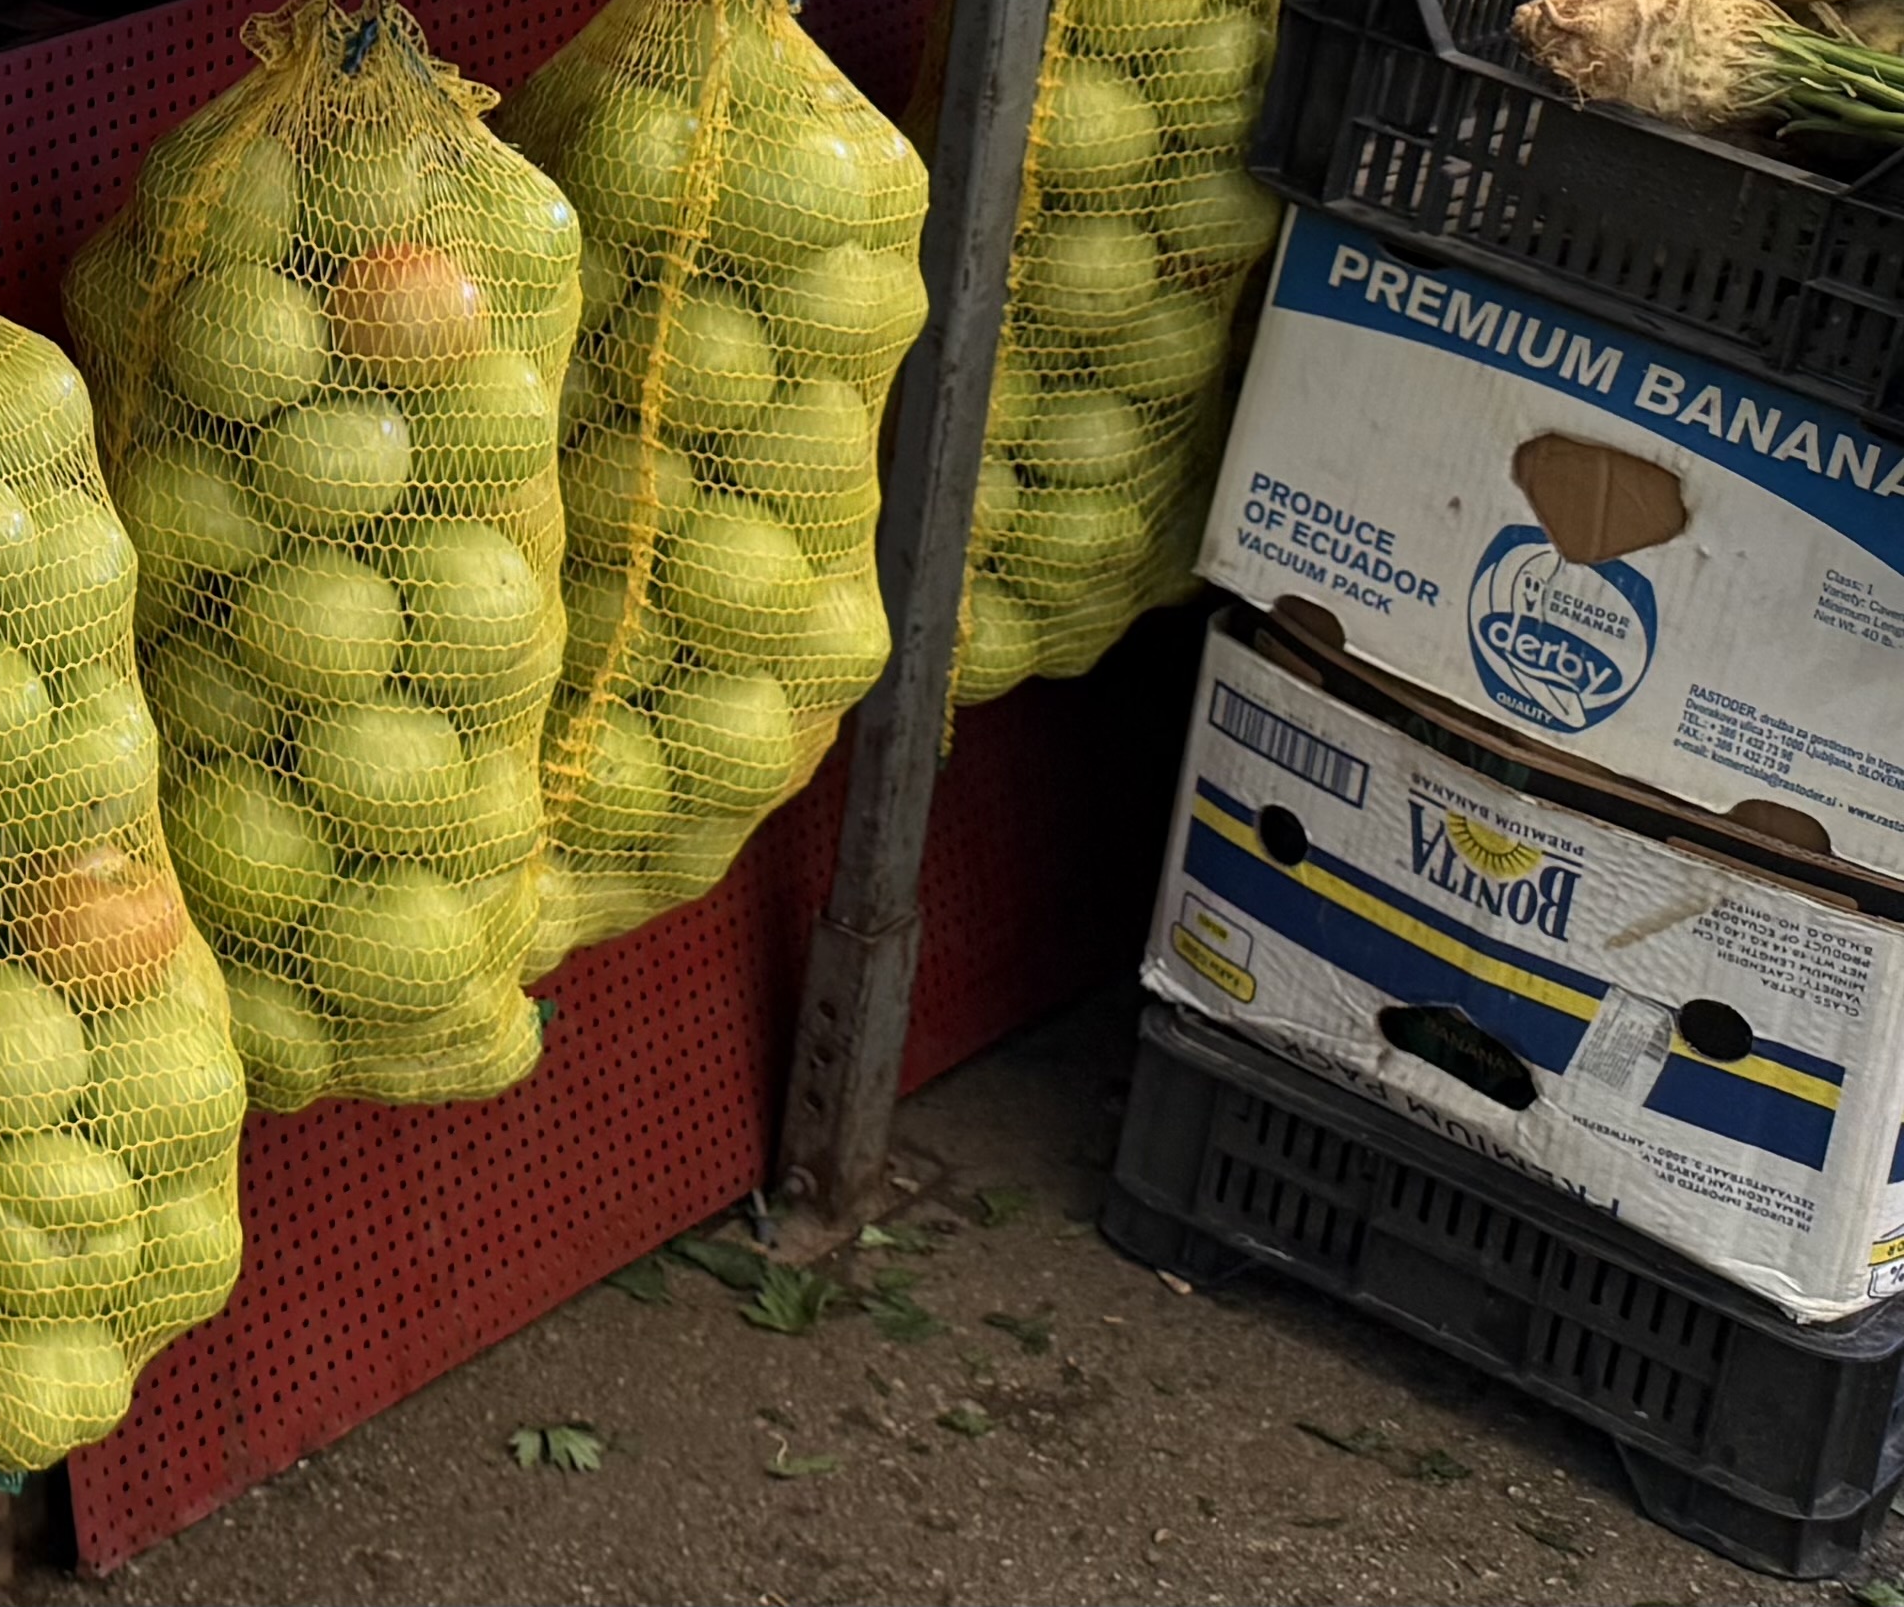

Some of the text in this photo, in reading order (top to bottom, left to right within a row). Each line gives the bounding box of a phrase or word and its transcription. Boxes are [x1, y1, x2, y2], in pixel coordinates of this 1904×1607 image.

[1327, 244, 1624, 395] PREMIUM
[1250, 471, 1396, 557] PRODUCE
[1244, 500, 1440, 607] OF ECUADOR
[1237, 526, 1394, 615] VACUUM PACK
[1550, 602, 1628, 641] BANANAS
[1553, 590, 1631, 629] ECUADOR
[1488, 612, 1613, 695] derby
[1496, 692, 1554, 725] QUALITY
[1411, 771, 1585, 857] PREMIUM BANANAS
[1407, 797, 1583, 943] BONITA
[1693, 926, 1715, 942] CM
[1710, 907, 1873, 969] PRODUCT OF ECUADOR
[1716, 949, 1796, 982] CAVENDISH
[1799, 963, 1866, 994] MINIMUM
[1839, 965, 1869, 982] NET
[1760, 976, 1807, 1000] EXTRA
[1677, 1178, 1743, 1208] IMPORTED
[1707, 1178, 1734, 1194] VAN
[1737, 1187, 1773, 1207] LEON
[1744, 1202, 1794, 1228] EUROPE
[1775, 1201, 1814, 1223] FIRMA
